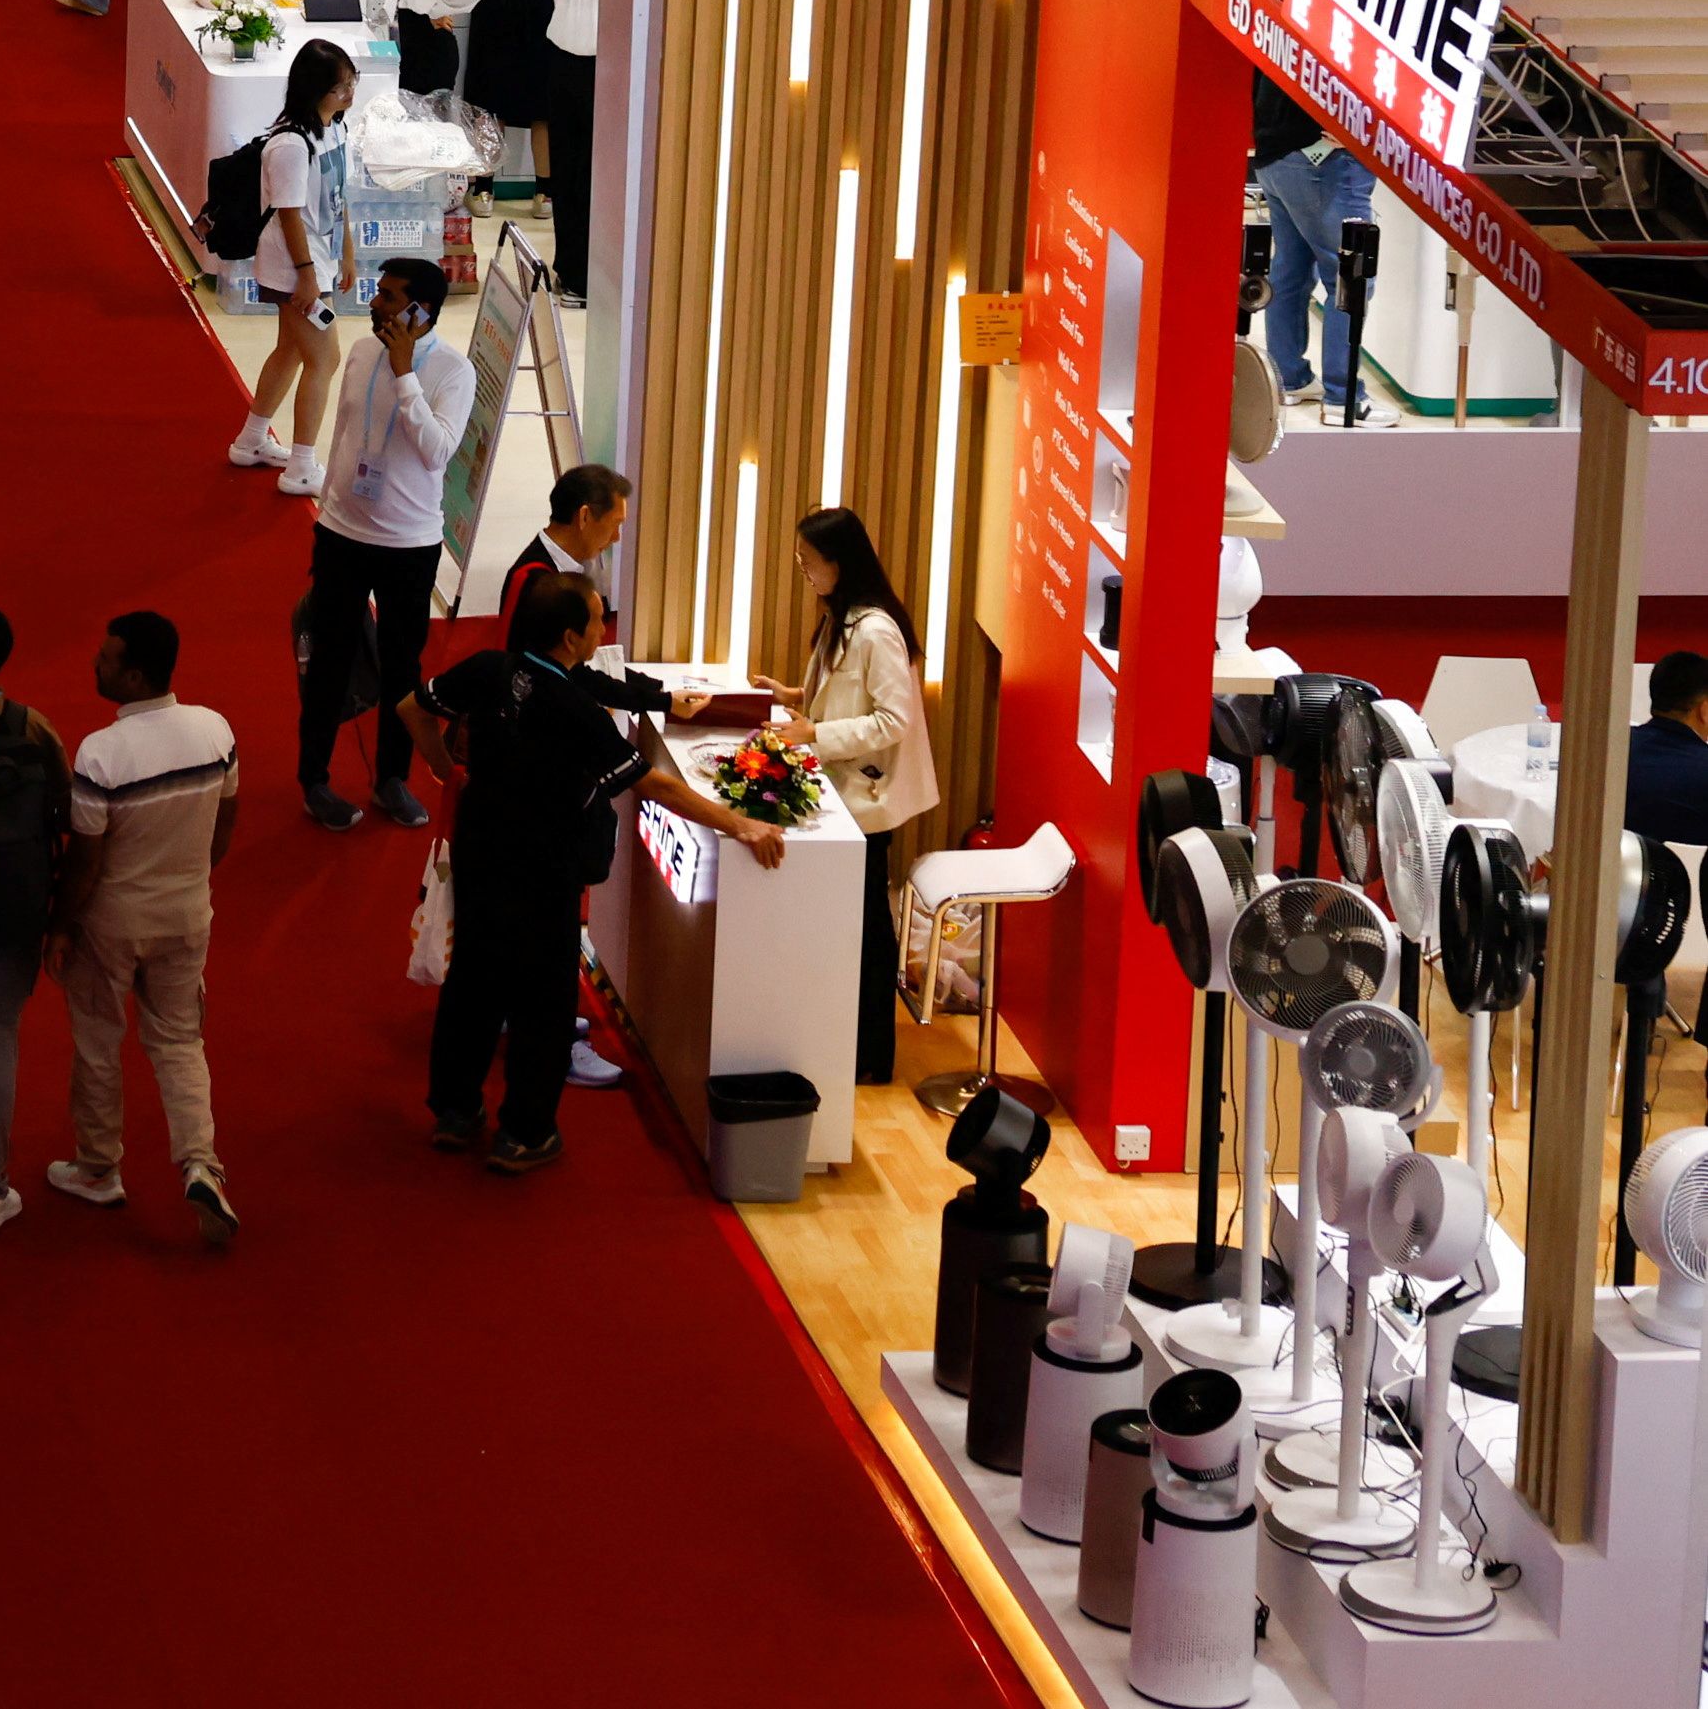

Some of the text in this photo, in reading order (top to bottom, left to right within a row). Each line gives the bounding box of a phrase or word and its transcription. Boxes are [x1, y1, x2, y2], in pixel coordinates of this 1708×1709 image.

[1252, 8, 1301, 82] SHINE
[1300, 48, 1373, 148] ELECTRIC
[1373, 119, 1473, 241] APPLIANCES
